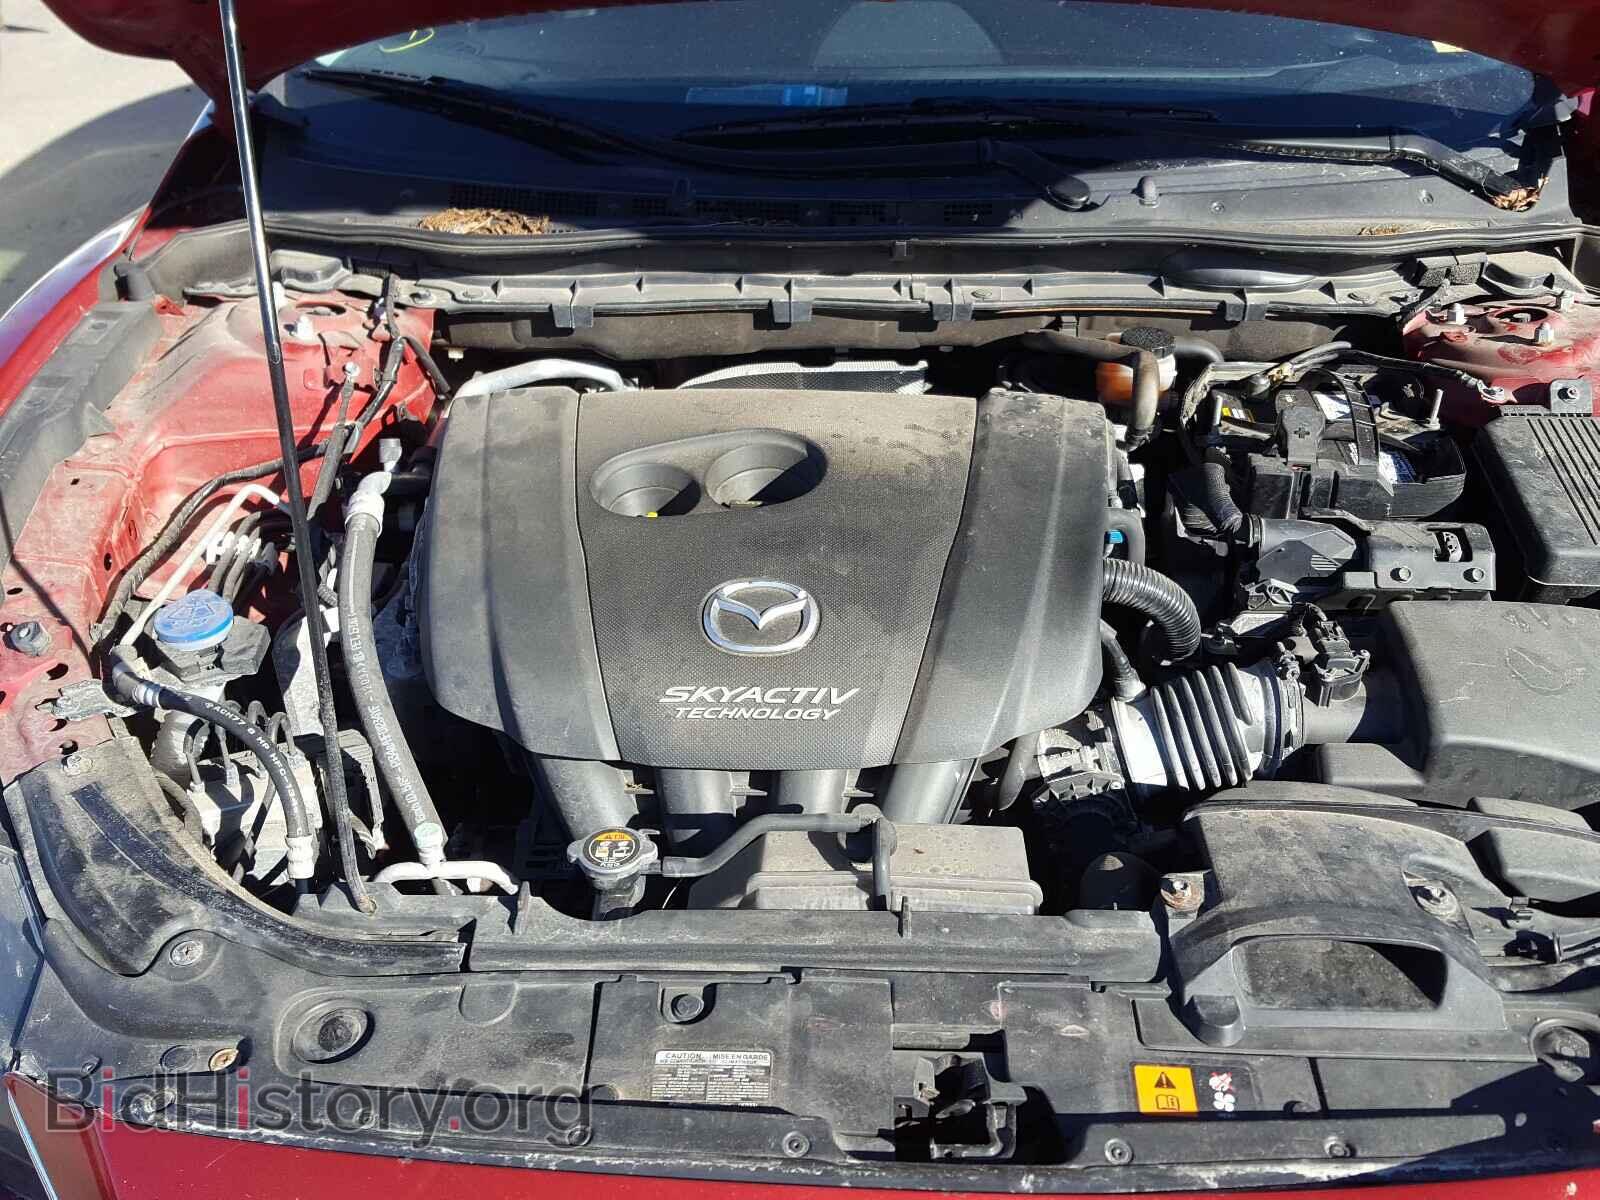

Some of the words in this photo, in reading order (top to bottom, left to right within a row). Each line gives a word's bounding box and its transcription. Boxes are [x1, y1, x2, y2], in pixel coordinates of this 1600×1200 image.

[659, 686, 860, 704] SKYACTIV
[675, 707, 840, 720] TECHNOLOGY
[665, 1052, 702, 1060] CAUTION
[742, 1053, 769, 1061] GARDE
